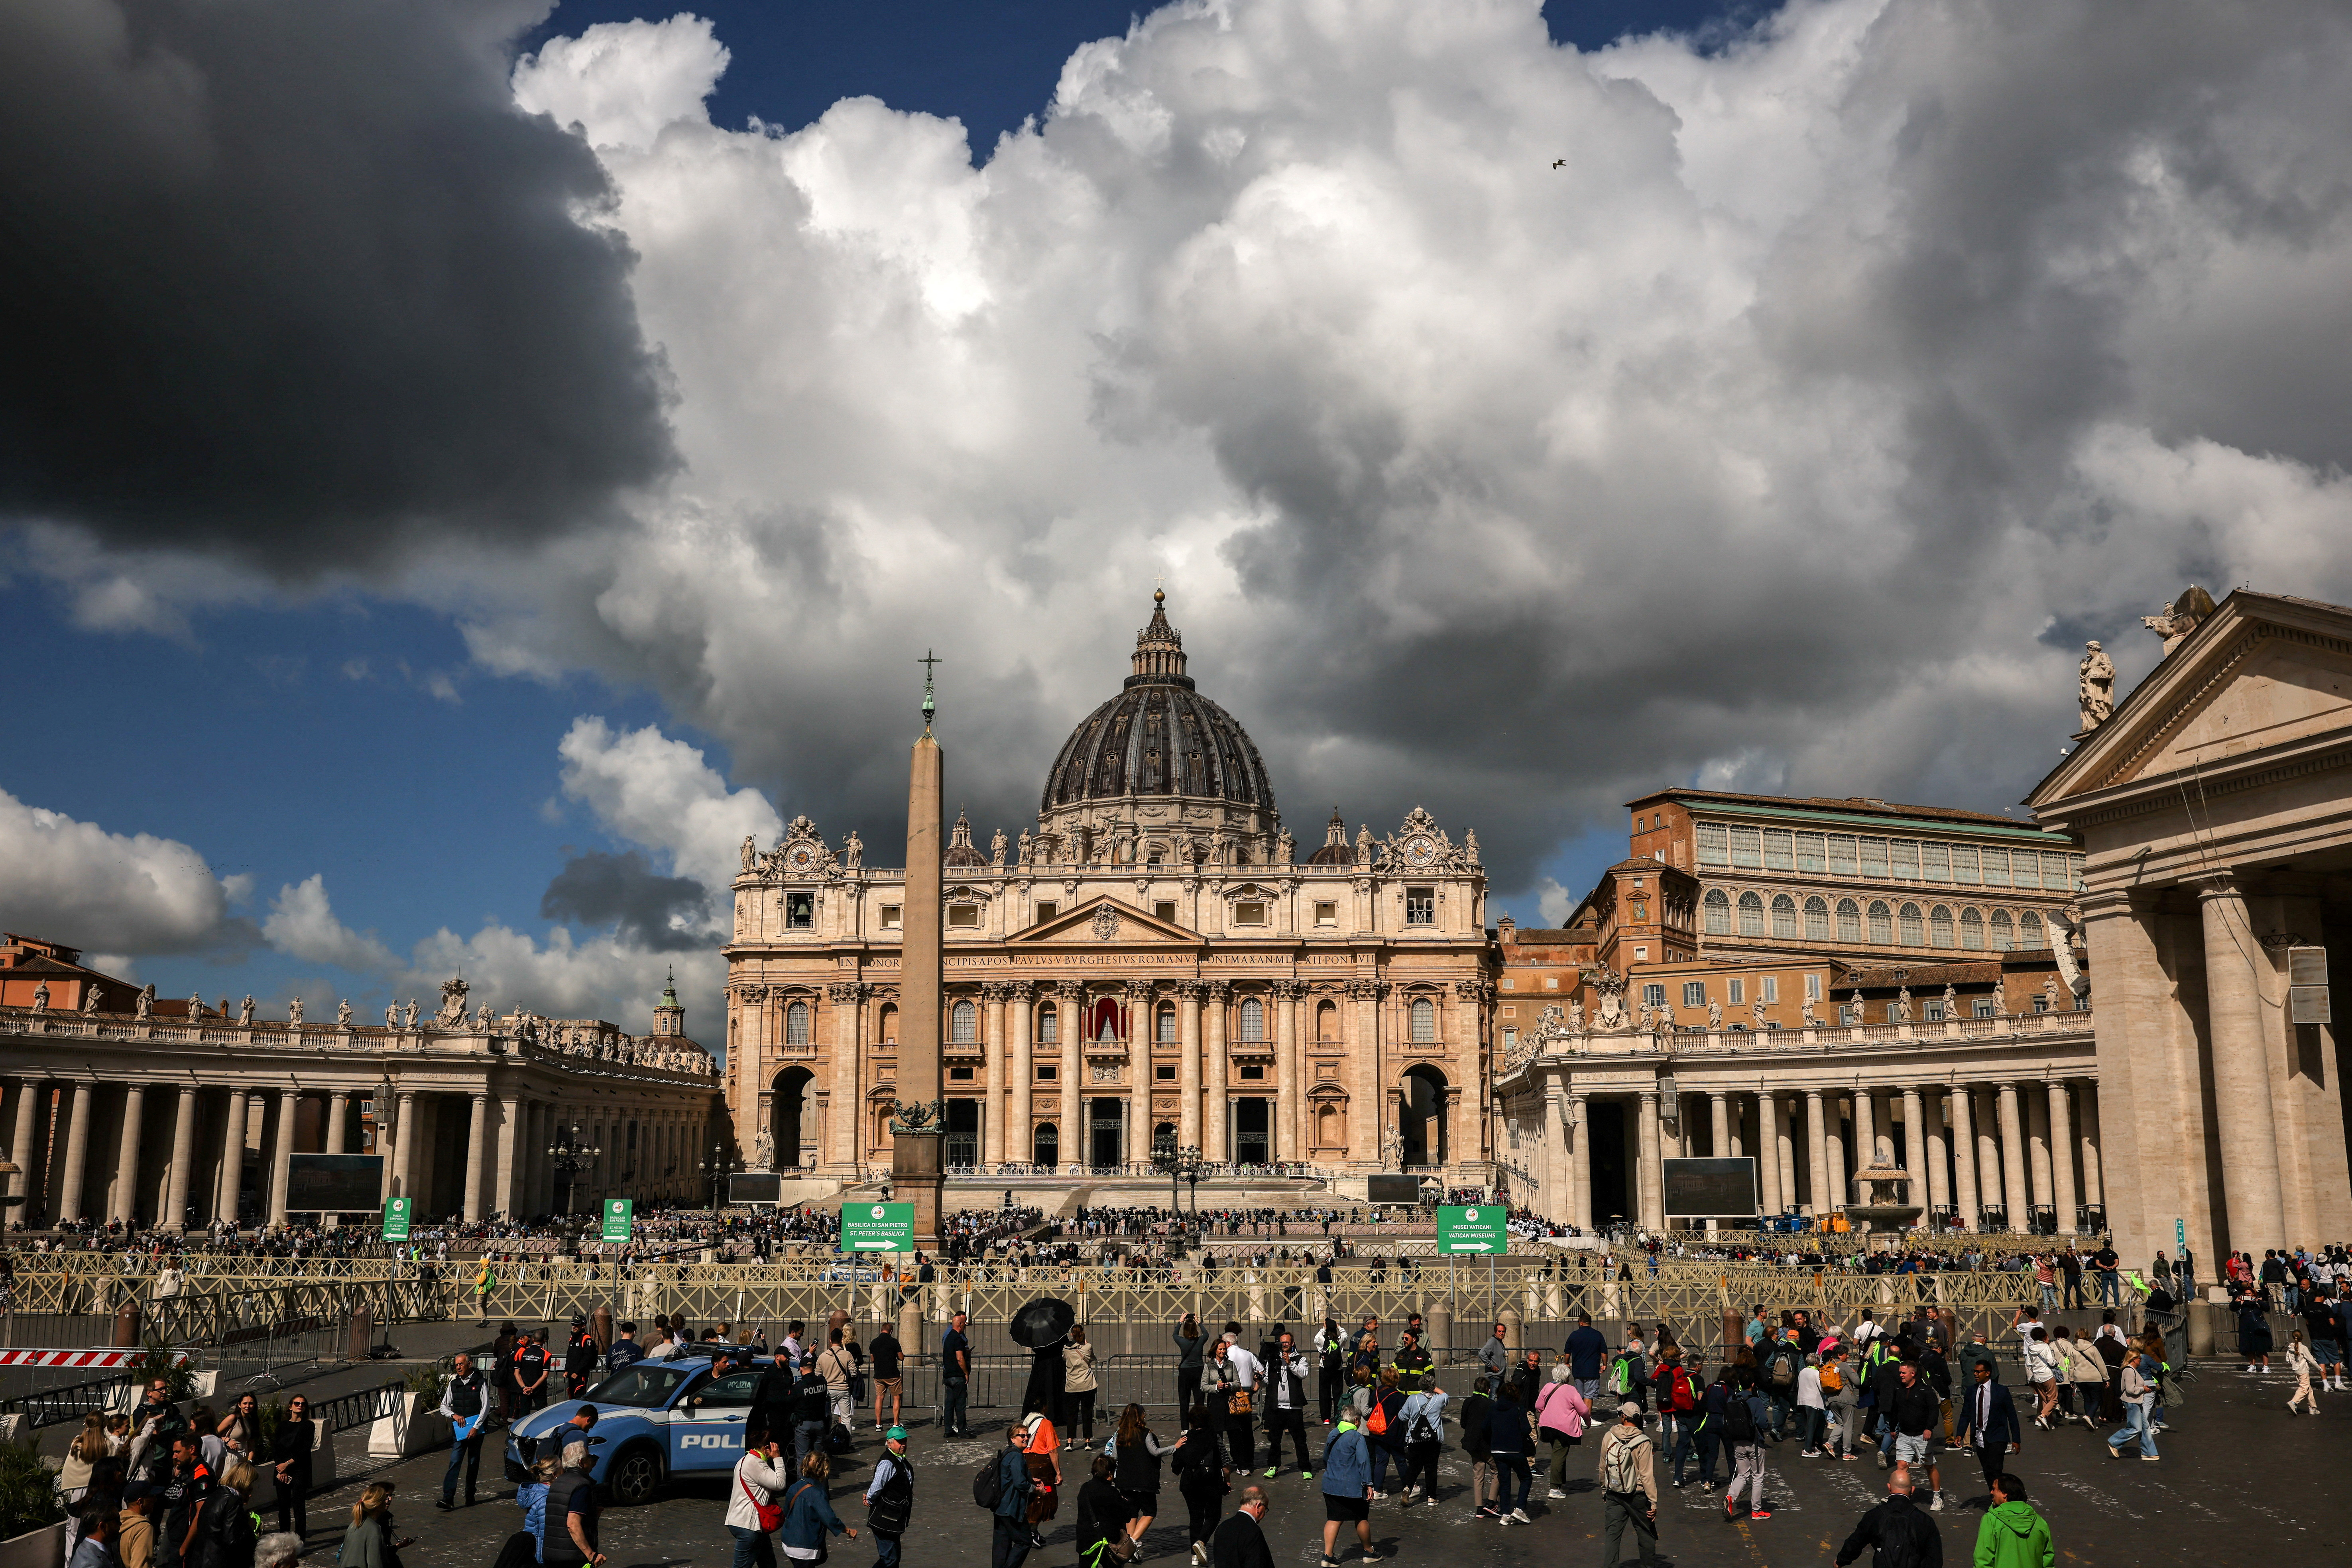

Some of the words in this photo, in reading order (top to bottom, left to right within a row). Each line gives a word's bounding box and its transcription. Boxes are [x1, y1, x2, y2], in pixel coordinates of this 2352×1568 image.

[840, 958, 853, 967] IN
[1015, 956, 1053, 965] PAVLVS
[1064, 955, 1135, 965] BVRGHESIVS
[1139, 955, 1197, 964] ROMANVS
[1358, 955, 1375, 963] VII
[803, 1384, 827, 1396] POLIZIA
[680, 1434, 745, 1449] POLI
